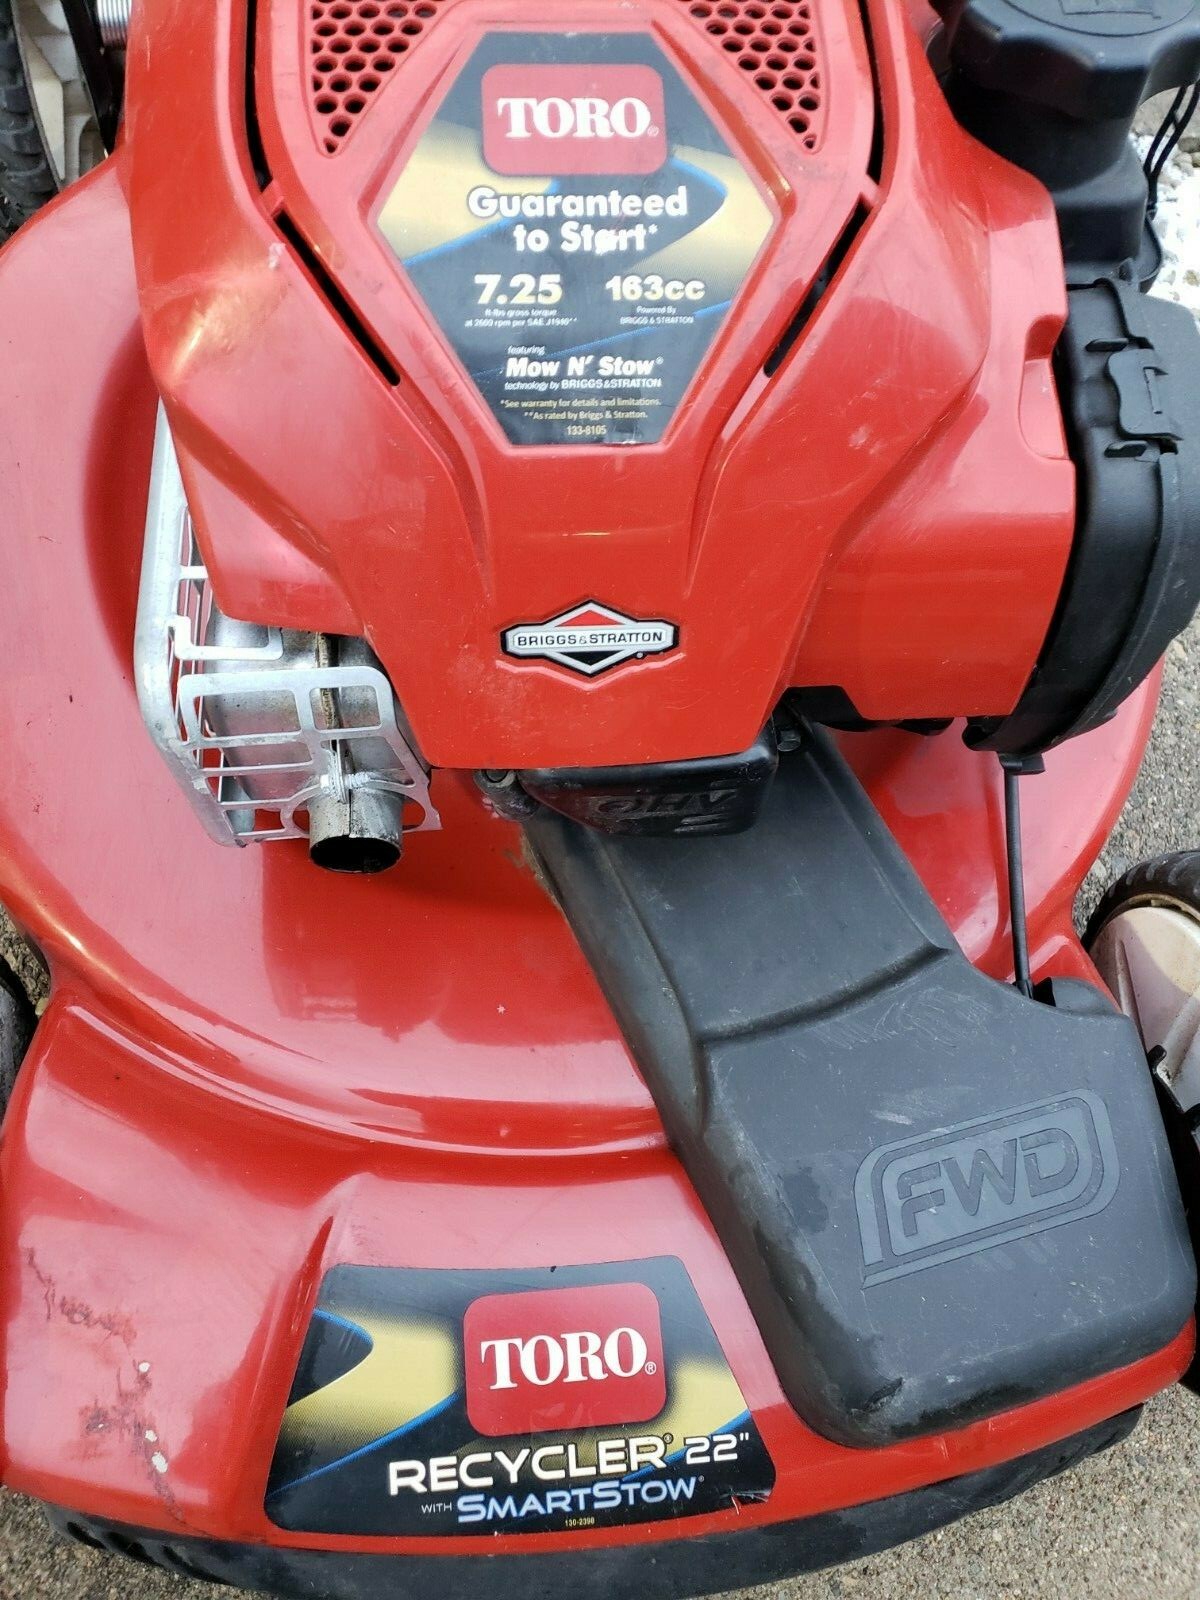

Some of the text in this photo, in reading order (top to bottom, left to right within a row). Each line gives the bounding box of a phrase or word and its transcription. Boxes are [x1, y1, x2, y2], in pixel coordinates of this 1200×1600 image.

[467, 185, 689, 218] Guaranteed
[513, 224, 549, 252] to
[474, 273, 563, 305] 7.25
[605, 274, 706, 301] 163cc
[636, 305, 677, 315] Powered By
[507, 345, 546, 356] featuring
[506, 357, 560, 377] Mow
[504, 381, 549, 391] technology
[550, 381, 561, 390] by
[521, 400, 557, 409] warranty
[558, 398, 570, 407] for
[571, 398, 599, 407] details
[600, 398, 616, 406] and
[544, 411, 566, 420] rated
[567, 411, 578, 421] by
[579, 411, 604, 421] Briggs
[605, 411, 612, 419] &
[567, 425, 607, 435] 133-8105
[897, 1128, 1079, 1238] FWD
[421, 1502, 452, 1514] WITH
